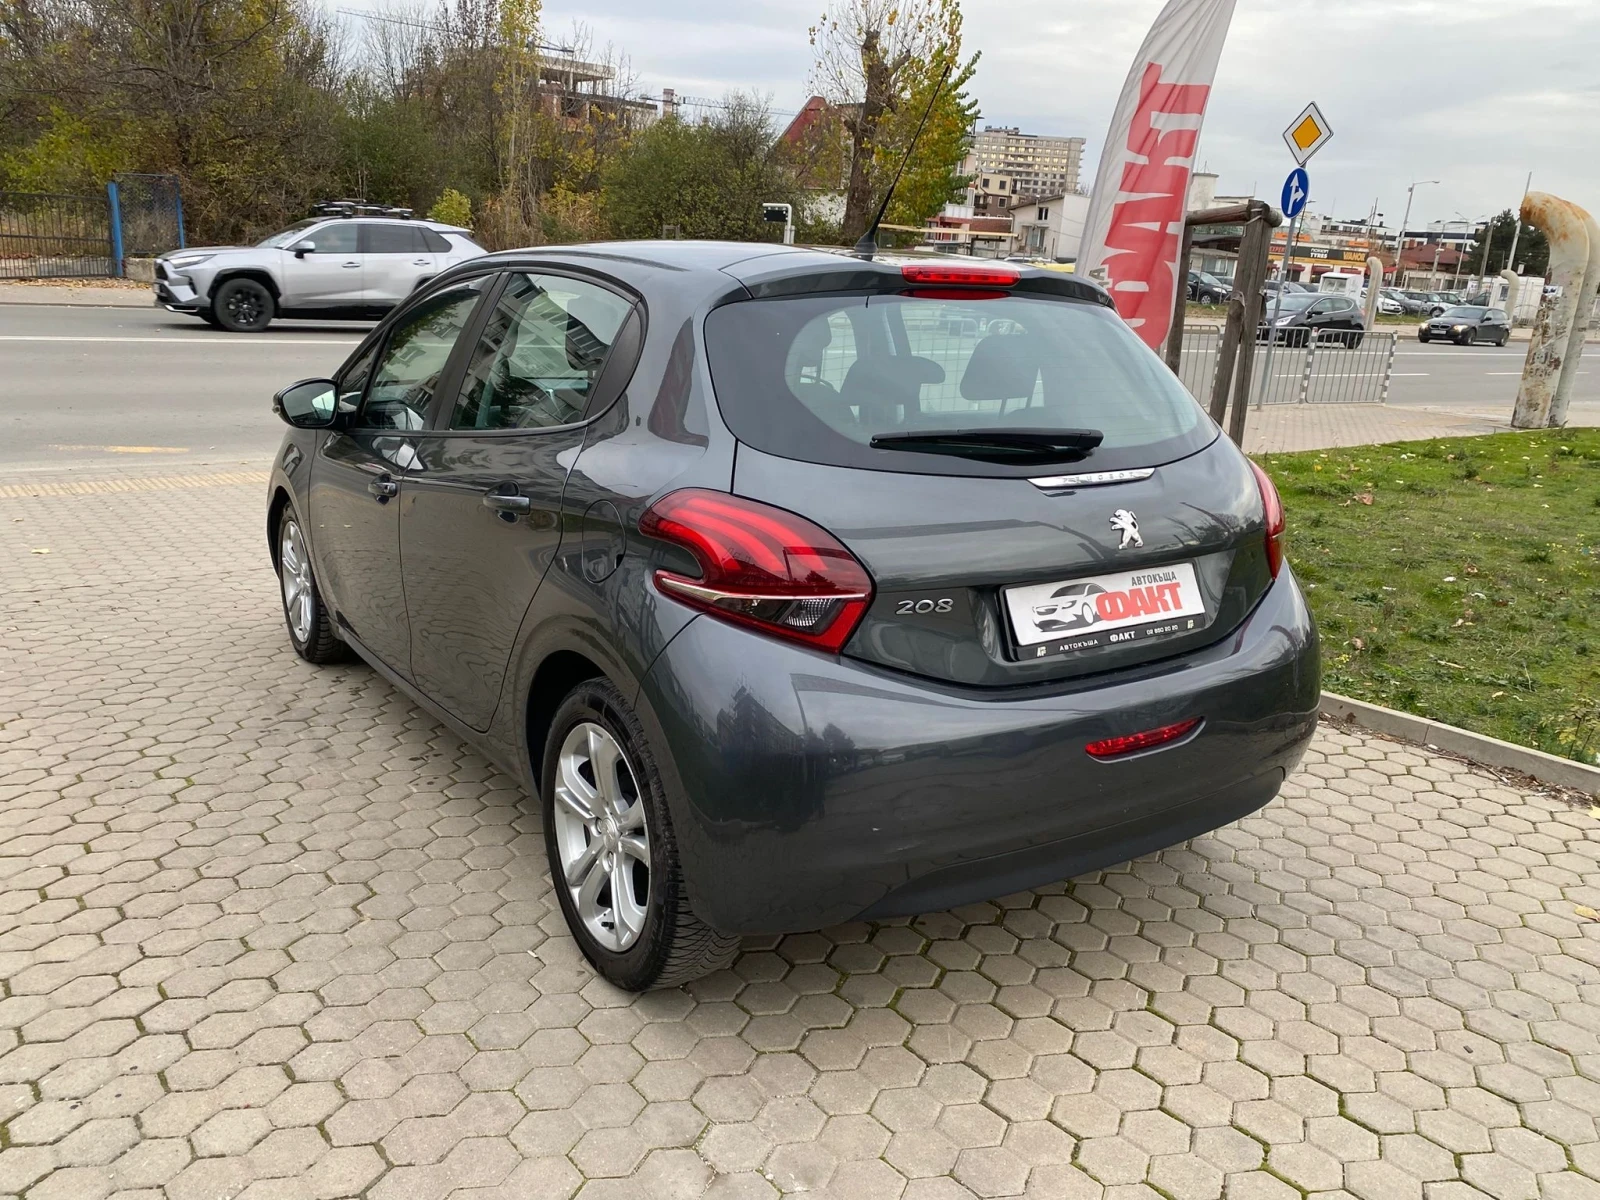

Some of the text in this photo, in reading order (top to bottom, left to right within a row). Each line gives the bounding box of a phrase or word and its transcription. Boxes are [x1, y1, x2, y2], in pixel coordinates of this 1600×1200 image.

[1101, 61, 1211, 349] ФАКТ
[1131, 571, 1177, 587] АВТОКЪЩА
[896, 598, 954, 615] 208
[1096, 582, 1183, 622] ФАКТ
[1110, 631, 1136, 642] ФАКТ
